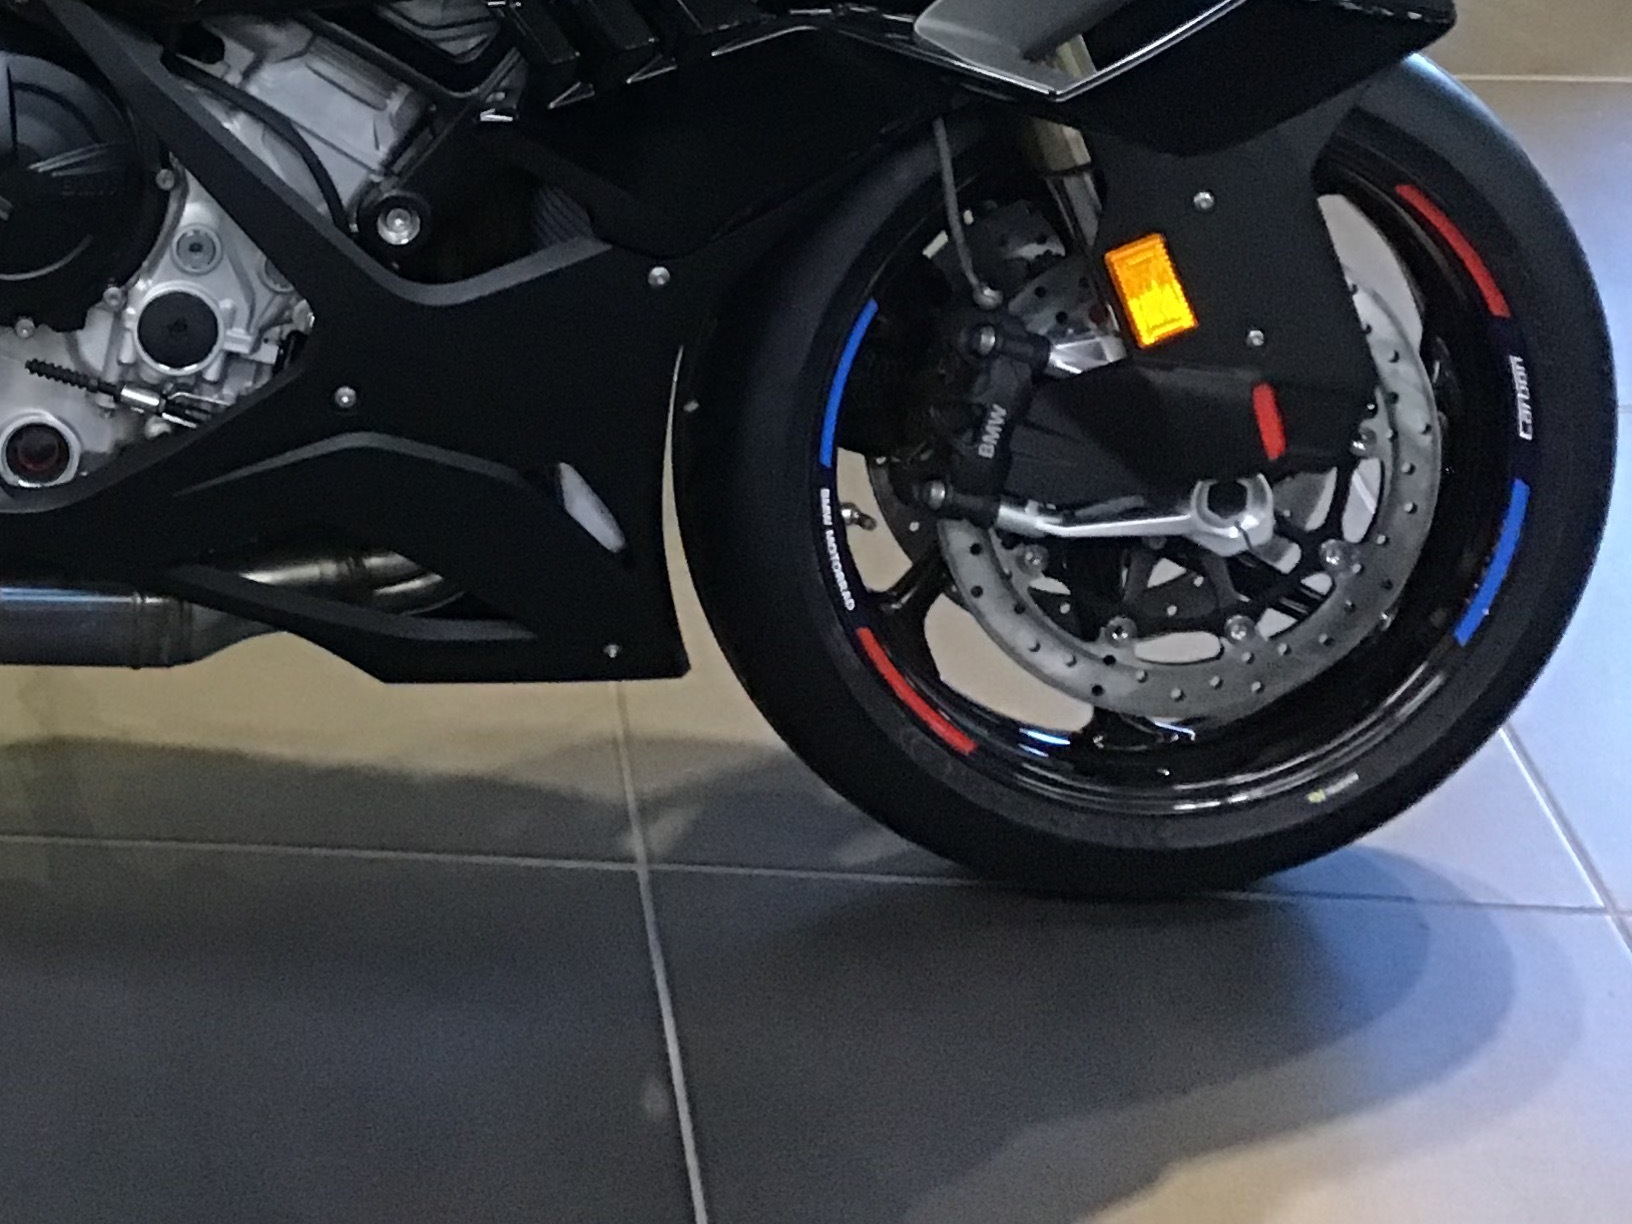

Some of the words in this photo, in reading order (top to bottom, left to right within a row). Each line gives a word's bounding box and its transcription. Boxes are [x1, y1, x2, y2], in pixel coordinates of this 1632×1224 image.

[978, 403, 1007, 459] BMW
[820, 487, 832, 526] BMW
[825, 529, 856, 611] MOTORRAD
